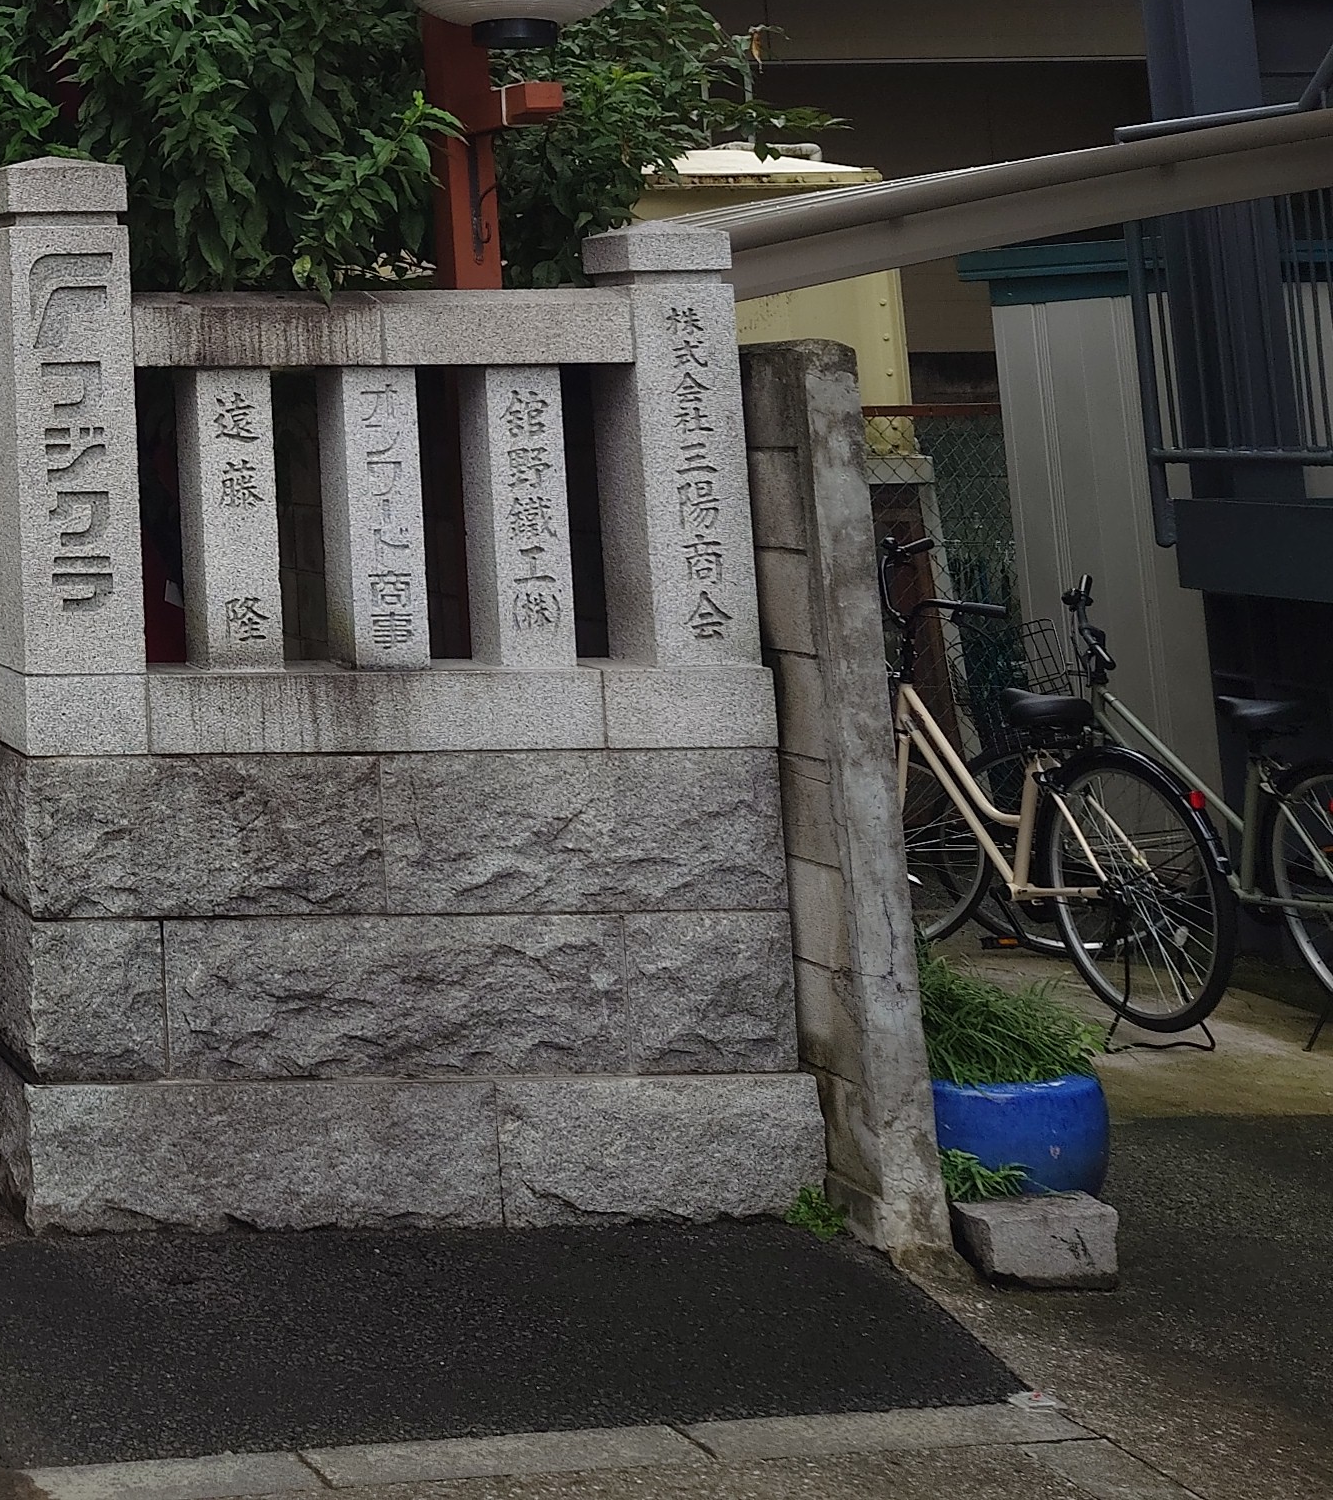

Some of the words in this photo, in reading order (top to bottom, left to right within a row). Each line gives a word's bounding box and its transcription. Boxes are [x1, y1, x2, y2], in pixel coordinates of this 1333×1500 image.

[666, 306, 733, 641] 株式会社三陽商会
